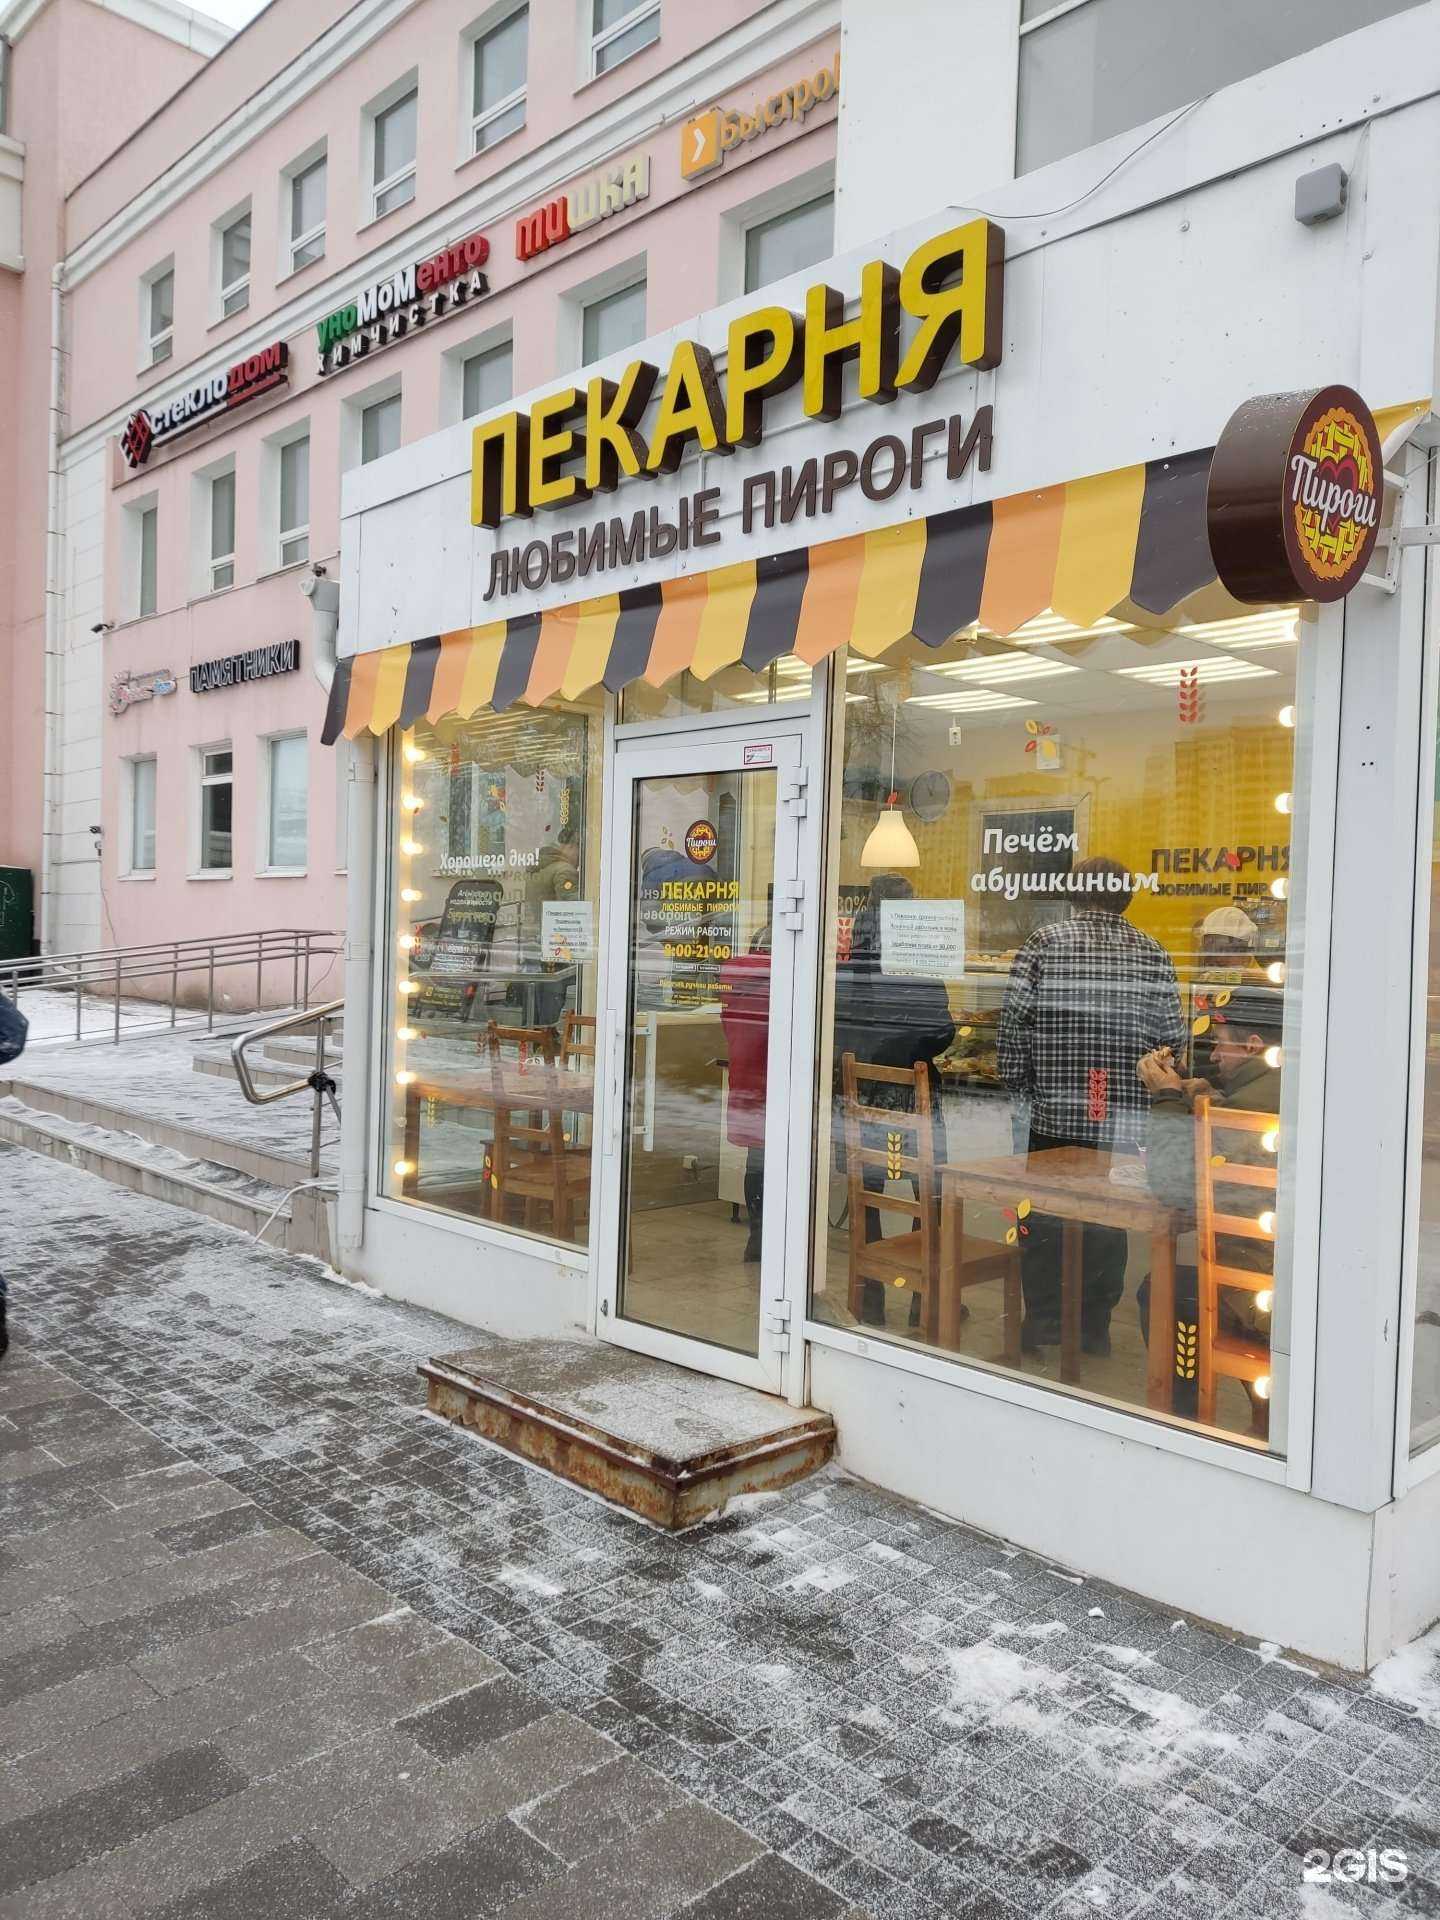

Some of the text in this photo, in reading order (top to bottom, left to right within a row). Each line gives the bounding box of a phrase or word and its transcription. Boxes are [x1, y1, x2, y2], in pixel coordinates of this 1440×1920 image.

[317, 270, 488, 375] ХИМЧИСТКА
[471, 219, 1005, 529] ПЕКАРНЯ
[483, 404, 993, 601] ЛЮБИМЫЕ ПИРОГИ
[189, 639, 300, 694] ПАМЯТНИКИ
[983, 826, 1079, 854] Печём
[440, 847, 540, 873] Хорошего дня!
[661, 881, 739, 900] ПЕКАРНЯ
[970, 866, 1160, 900] абушкиным
[661, 903, 739, 913] ЛЮБИМЫЕ ПИРОГ
[664, 926, 732, 937] РЕЖИМ РАБОТЫ
